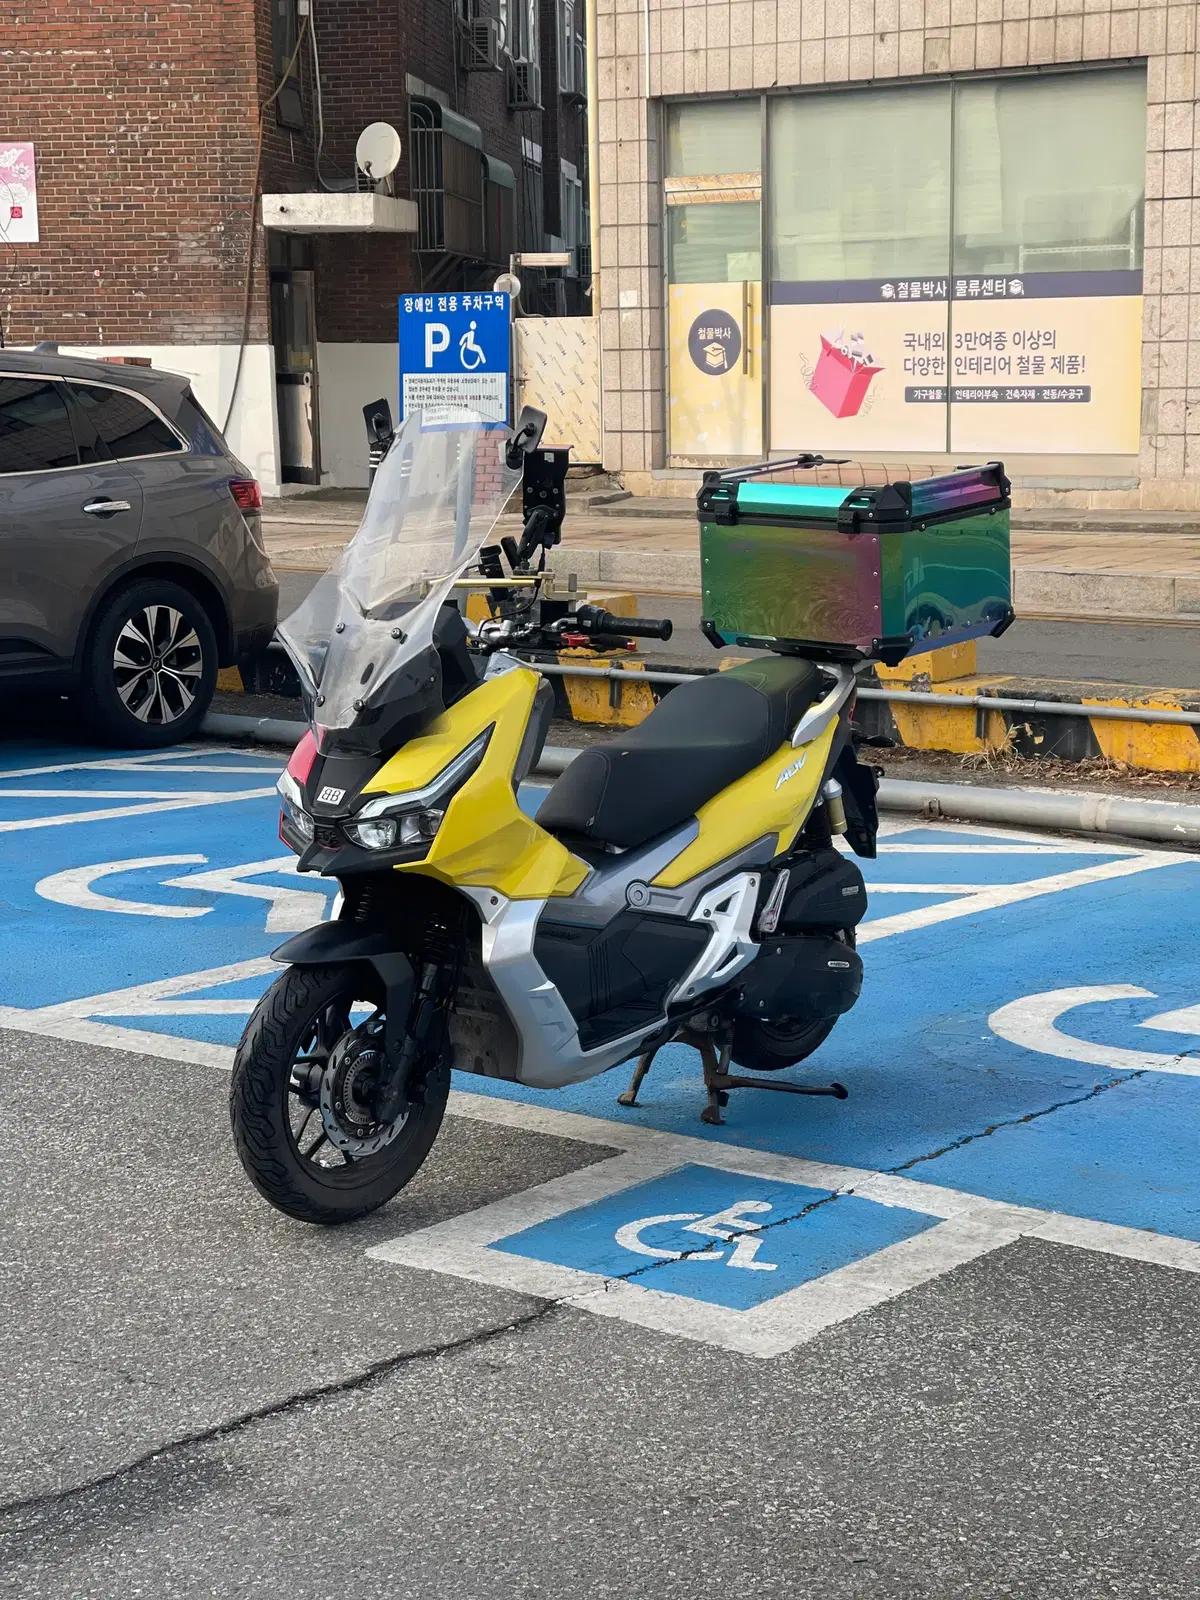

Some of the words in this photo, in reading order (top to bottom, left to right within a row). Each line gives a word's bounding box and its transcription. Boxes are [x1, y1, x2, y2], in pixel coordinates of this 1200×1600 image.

[897, 280, 947, 298] 철물박사
[955, 278, 1006, 297] 물류센터
[404, 297, 433, 313] 장애인
[438, 296, 458, 312] 전용
[462, 295, 504, 311] 주차구역
[697, 327, 731, 340] 철물박사
[903, 332, 945, 352] 국내외
[954, 331, 1008, 351] 3만여종
[1012, 329, 1057, 351] 이상의
[424, 322, 451, 368] P
[903, 355, 945, 377] 다양한
[954, 355, 1012, 376] 인테리어
[1016, 355, 1046, 376] 철물
[1050, 354, 1086, 375] 제품!
